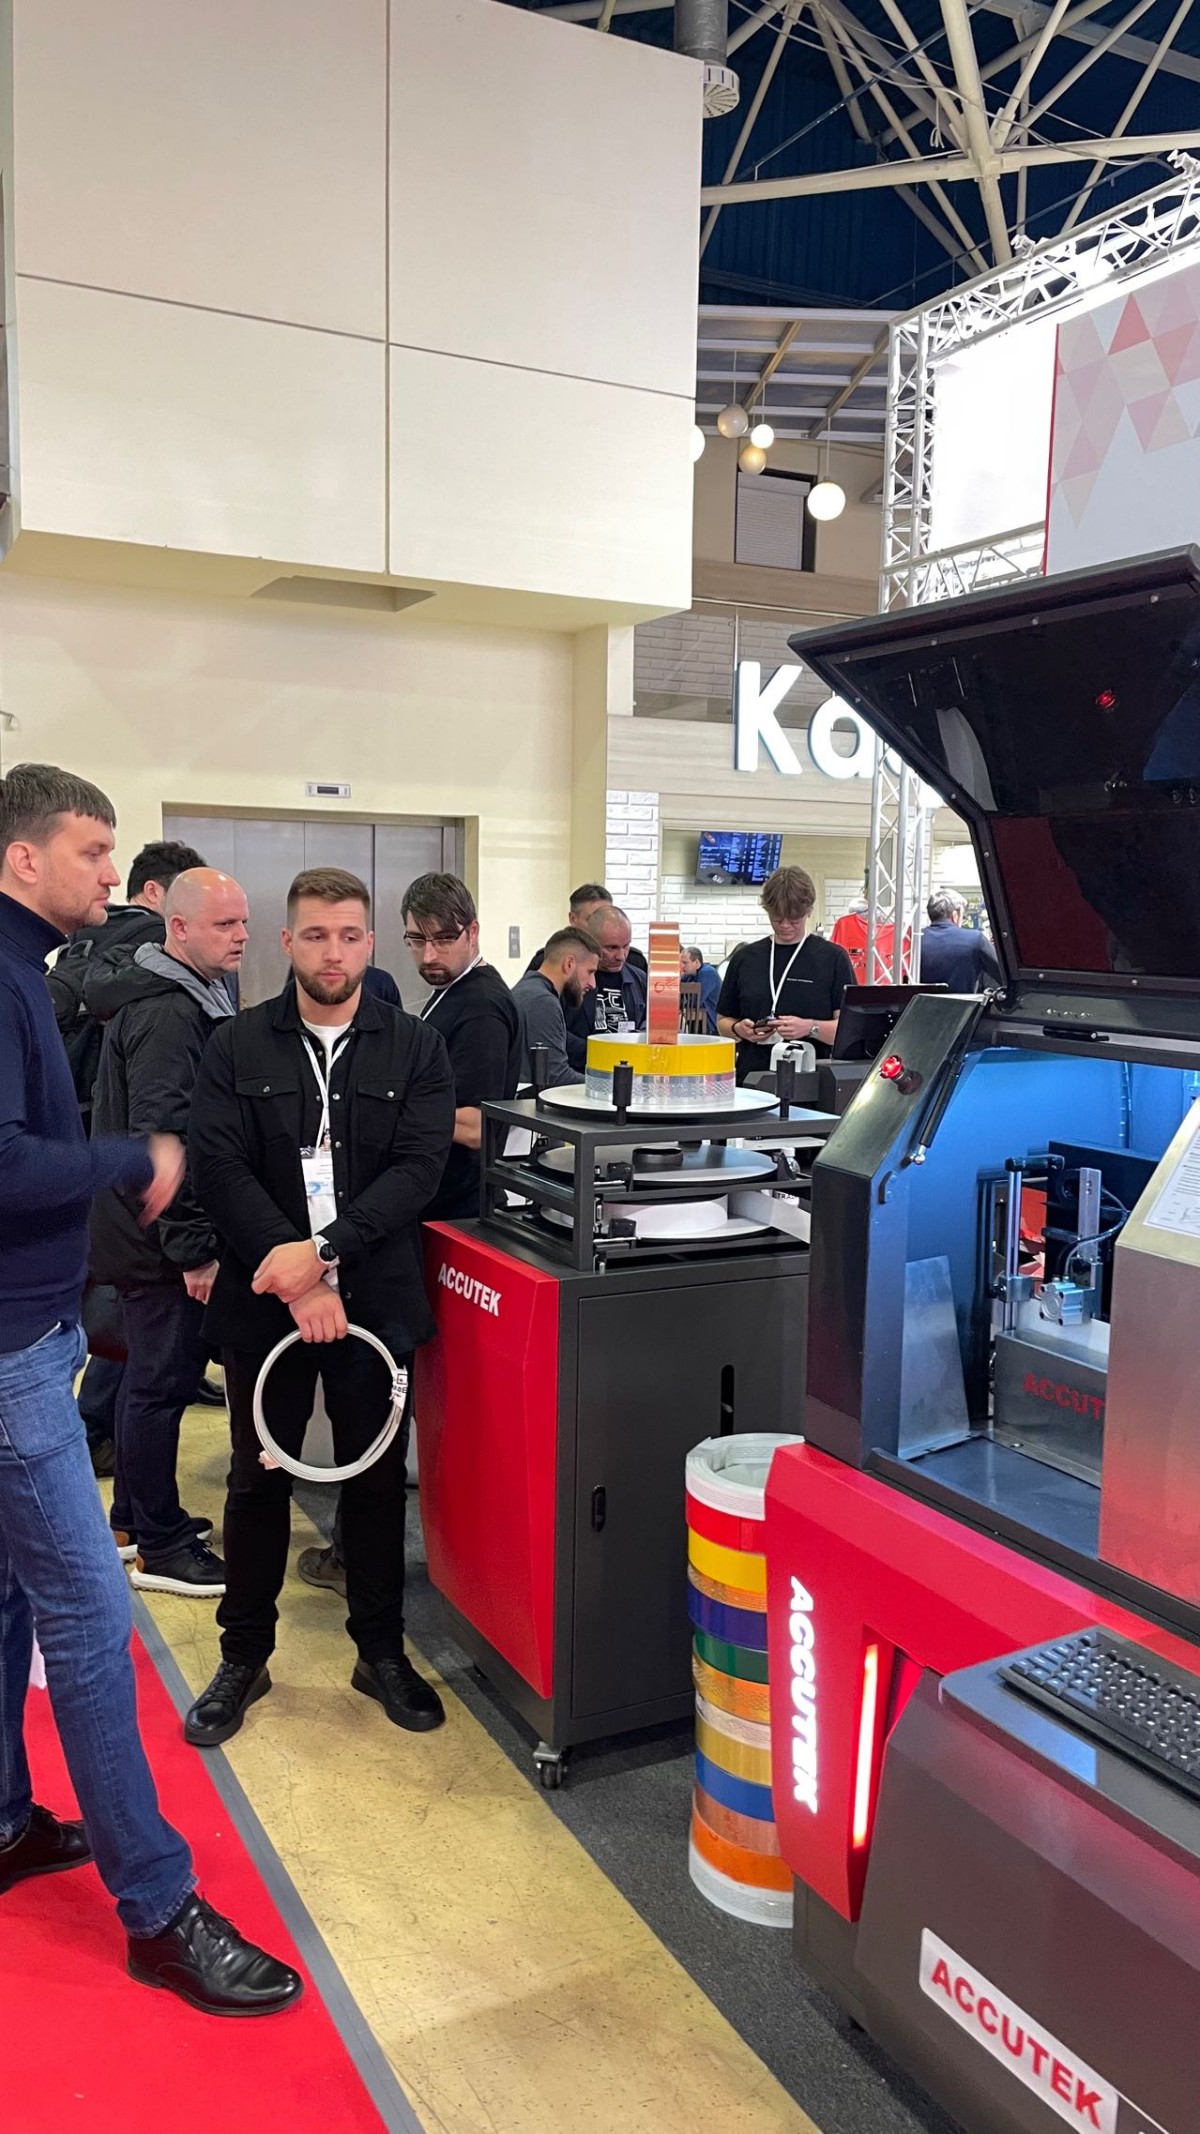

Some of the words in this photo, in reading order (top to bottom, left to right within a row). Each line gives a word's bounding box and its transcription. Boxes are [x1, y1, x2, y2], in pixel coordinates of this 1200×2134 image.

[438, 1262, 502, 1317] ACCUTEK
[789, 1575, 818, 1815] ACCUTEK
[931, 1958, 1103, 2130] ACCUTEK
